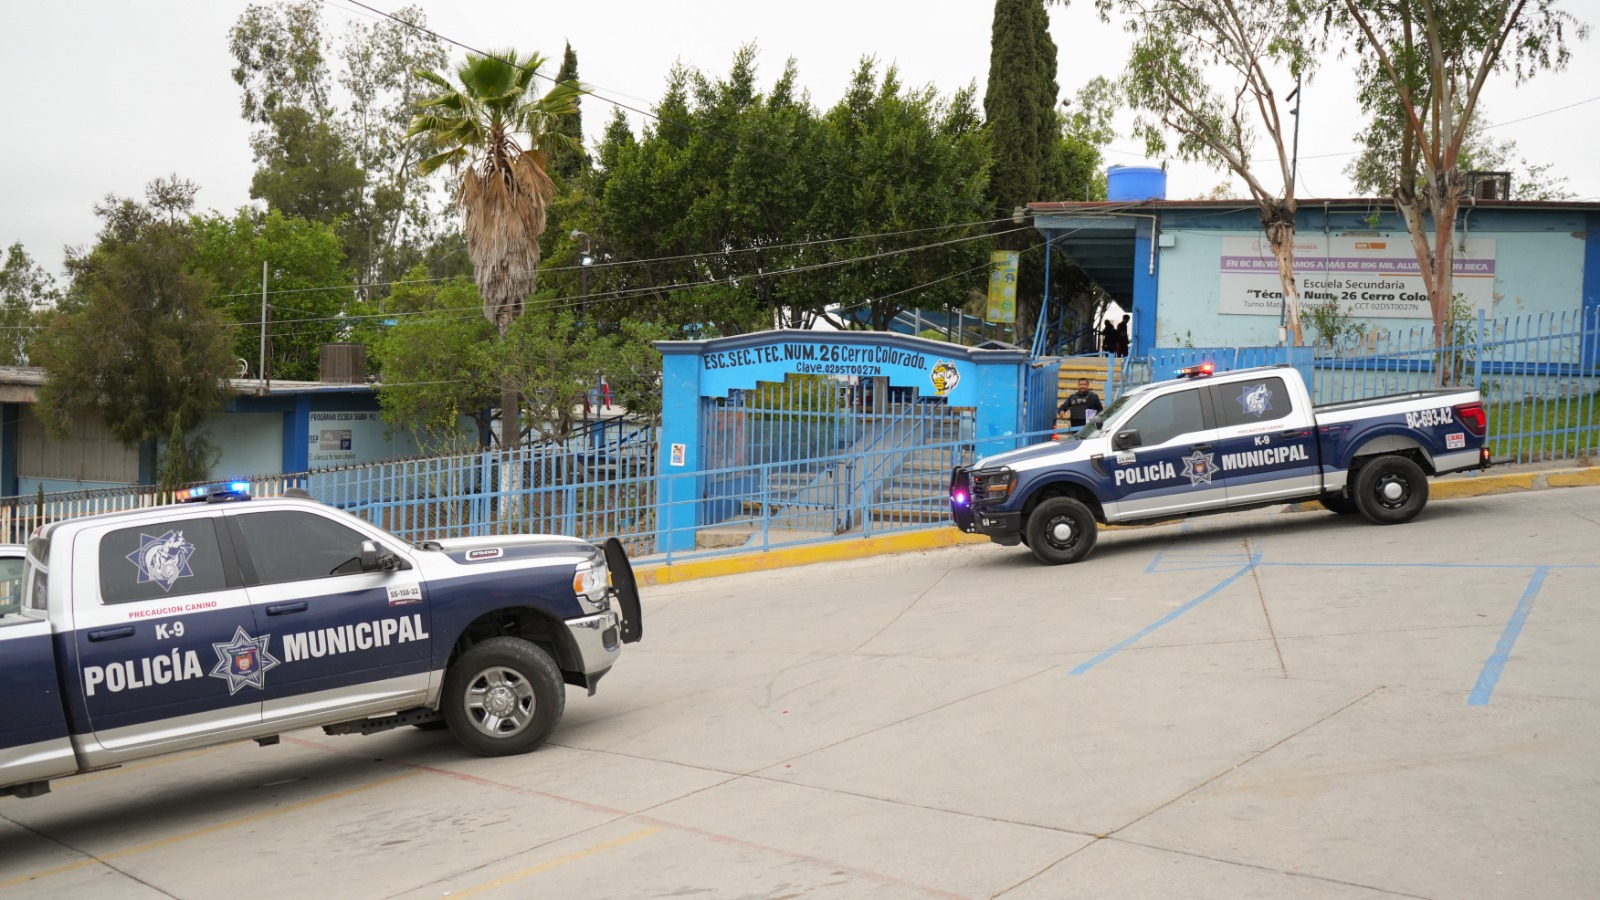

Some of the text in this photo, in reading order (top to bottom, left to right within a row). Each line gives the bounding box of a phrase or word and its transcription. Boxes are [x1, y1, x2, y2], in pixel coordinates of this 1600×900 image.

[1226, 260, 1238, 268] EN
[1240, 260, 1251, 268] BC
[1253, 260, 1316, 269] BENEFAMOS
[1326, 259, 1346, 269] MÁS
[1347, 261, 1359, 269] DE
[1361, 261, 1377, 269] 896
[1379, 261, 1395, 270] MIL
[1465, 263, 1488, 271] BECA
[1303, 279, 1405, 289] Escuela Secundaria
[1246, 289, 1300, 299] “Técn
[1341, 291, 1357, 300] 26
[1361, 291, 1395, 301] Cerro
[1244, 300, 1264, 308] Turno
[1355, 302, 1370, 310] CCT
[1371, 303, 1419, 311] 02DST0027N
[841, 345, 874, 362] Cerro
[1405, 406, 1454, 429] BC-693-A2
[1254, 435, 1270, 446] K-9
[1114, 443, 1309, 486] POLICÍA MUNICIPAL
[128, 600, 217, 619] PRECAUCION CANINO
[154, 620, 185, 641] K-9
[83, 613, 429, 697] POLICÍA MUNICIPAL
